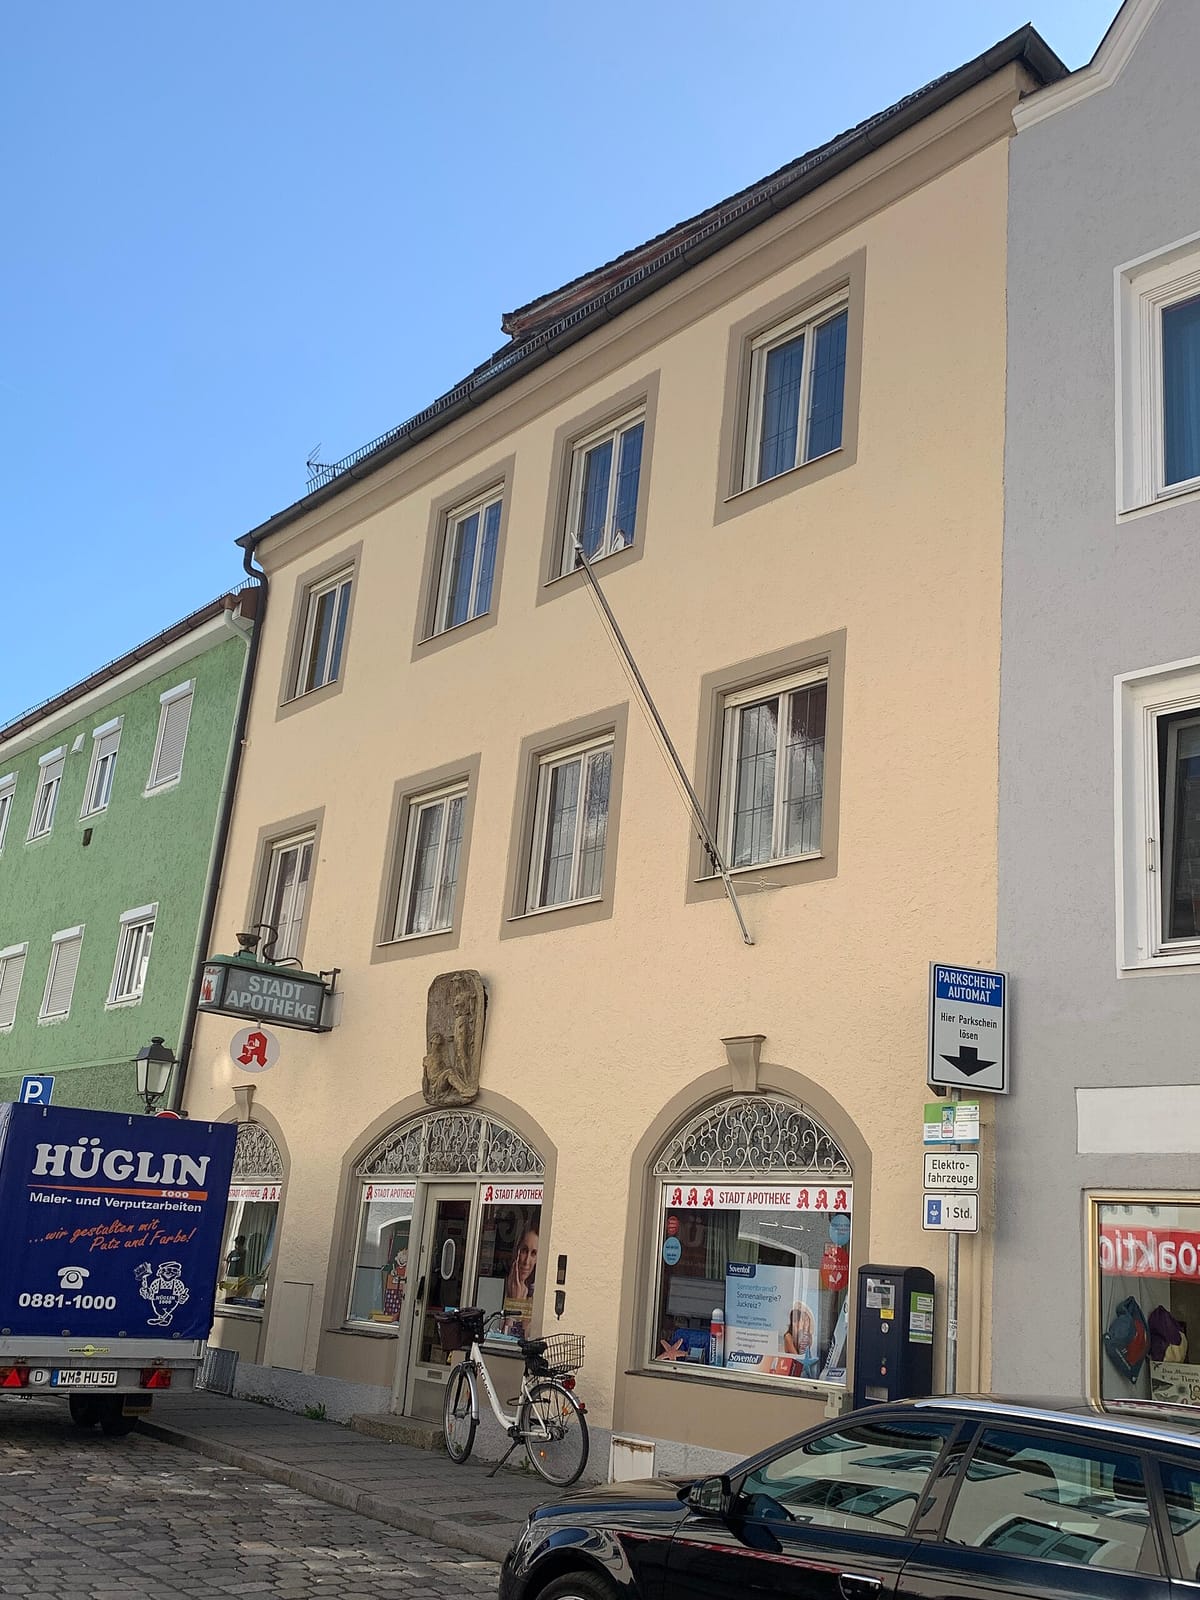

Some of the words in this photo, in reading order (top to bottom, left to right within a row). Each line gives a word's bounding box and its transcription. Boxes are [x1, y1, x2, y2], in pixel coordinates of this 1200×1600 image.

[938, 970, 1000, 990] PARKSCHEIN-
[249, 975, 305, 1000] STADT
[948, 986, 991, 1003] AUTOMAT
[225, 990, 316, 1021] APOTHEKE
[941, 1012, 956, 1023] Hier
[959, 1014, 997, 1029] Parkschein
[959, 1029, 979, 1041] lösen
[24, 1080, 43, 1104] P
[31, 1137, 211, 1186] HÜGLIN
[932, 1159, 970, 1170] Elektro-
[928, 1172, 974, 1185] fahrzeuge
[161, 1190, 190, 1199] 1000
[495, 1189, 513, 1199] STADT
[719, 1191, 746, 1205] STADT
[746, 1192, 791, 1206] APOTHEKE
[29, 1191, 72, 1204] Maler-
[76, 1196, 101, 1206] und
[104, 1198, 202, 1213] Verputzarbeiten
[946, 1207, 950, 1218] 1
[953, 1206, 972, 1219] Std.
[69, 1219, 135, 1244] gestalten
[138, 1218, 160, 1232] mit
[89, 1236, 120, 1252] Putz
[124, 1233, 149, 1248] und
[150, 1228, 197, 1246] Farbe!
[729, 1263, 751, 1274] Soventol
[18, 1292, 117, 1310] 0881-1000
[736, 1291, 781, 1303] Sonnenallergie?
[736, 1300, 761, 1308] Juckreiz?
[730, 1352, 759, 1363] Soventol
[35, 1371, 43, 1382] D
[60, 1371, 76, 1384] WM
[84, 1372, 99, 1384] HU
[101, 1372, 115, 1384] 50
